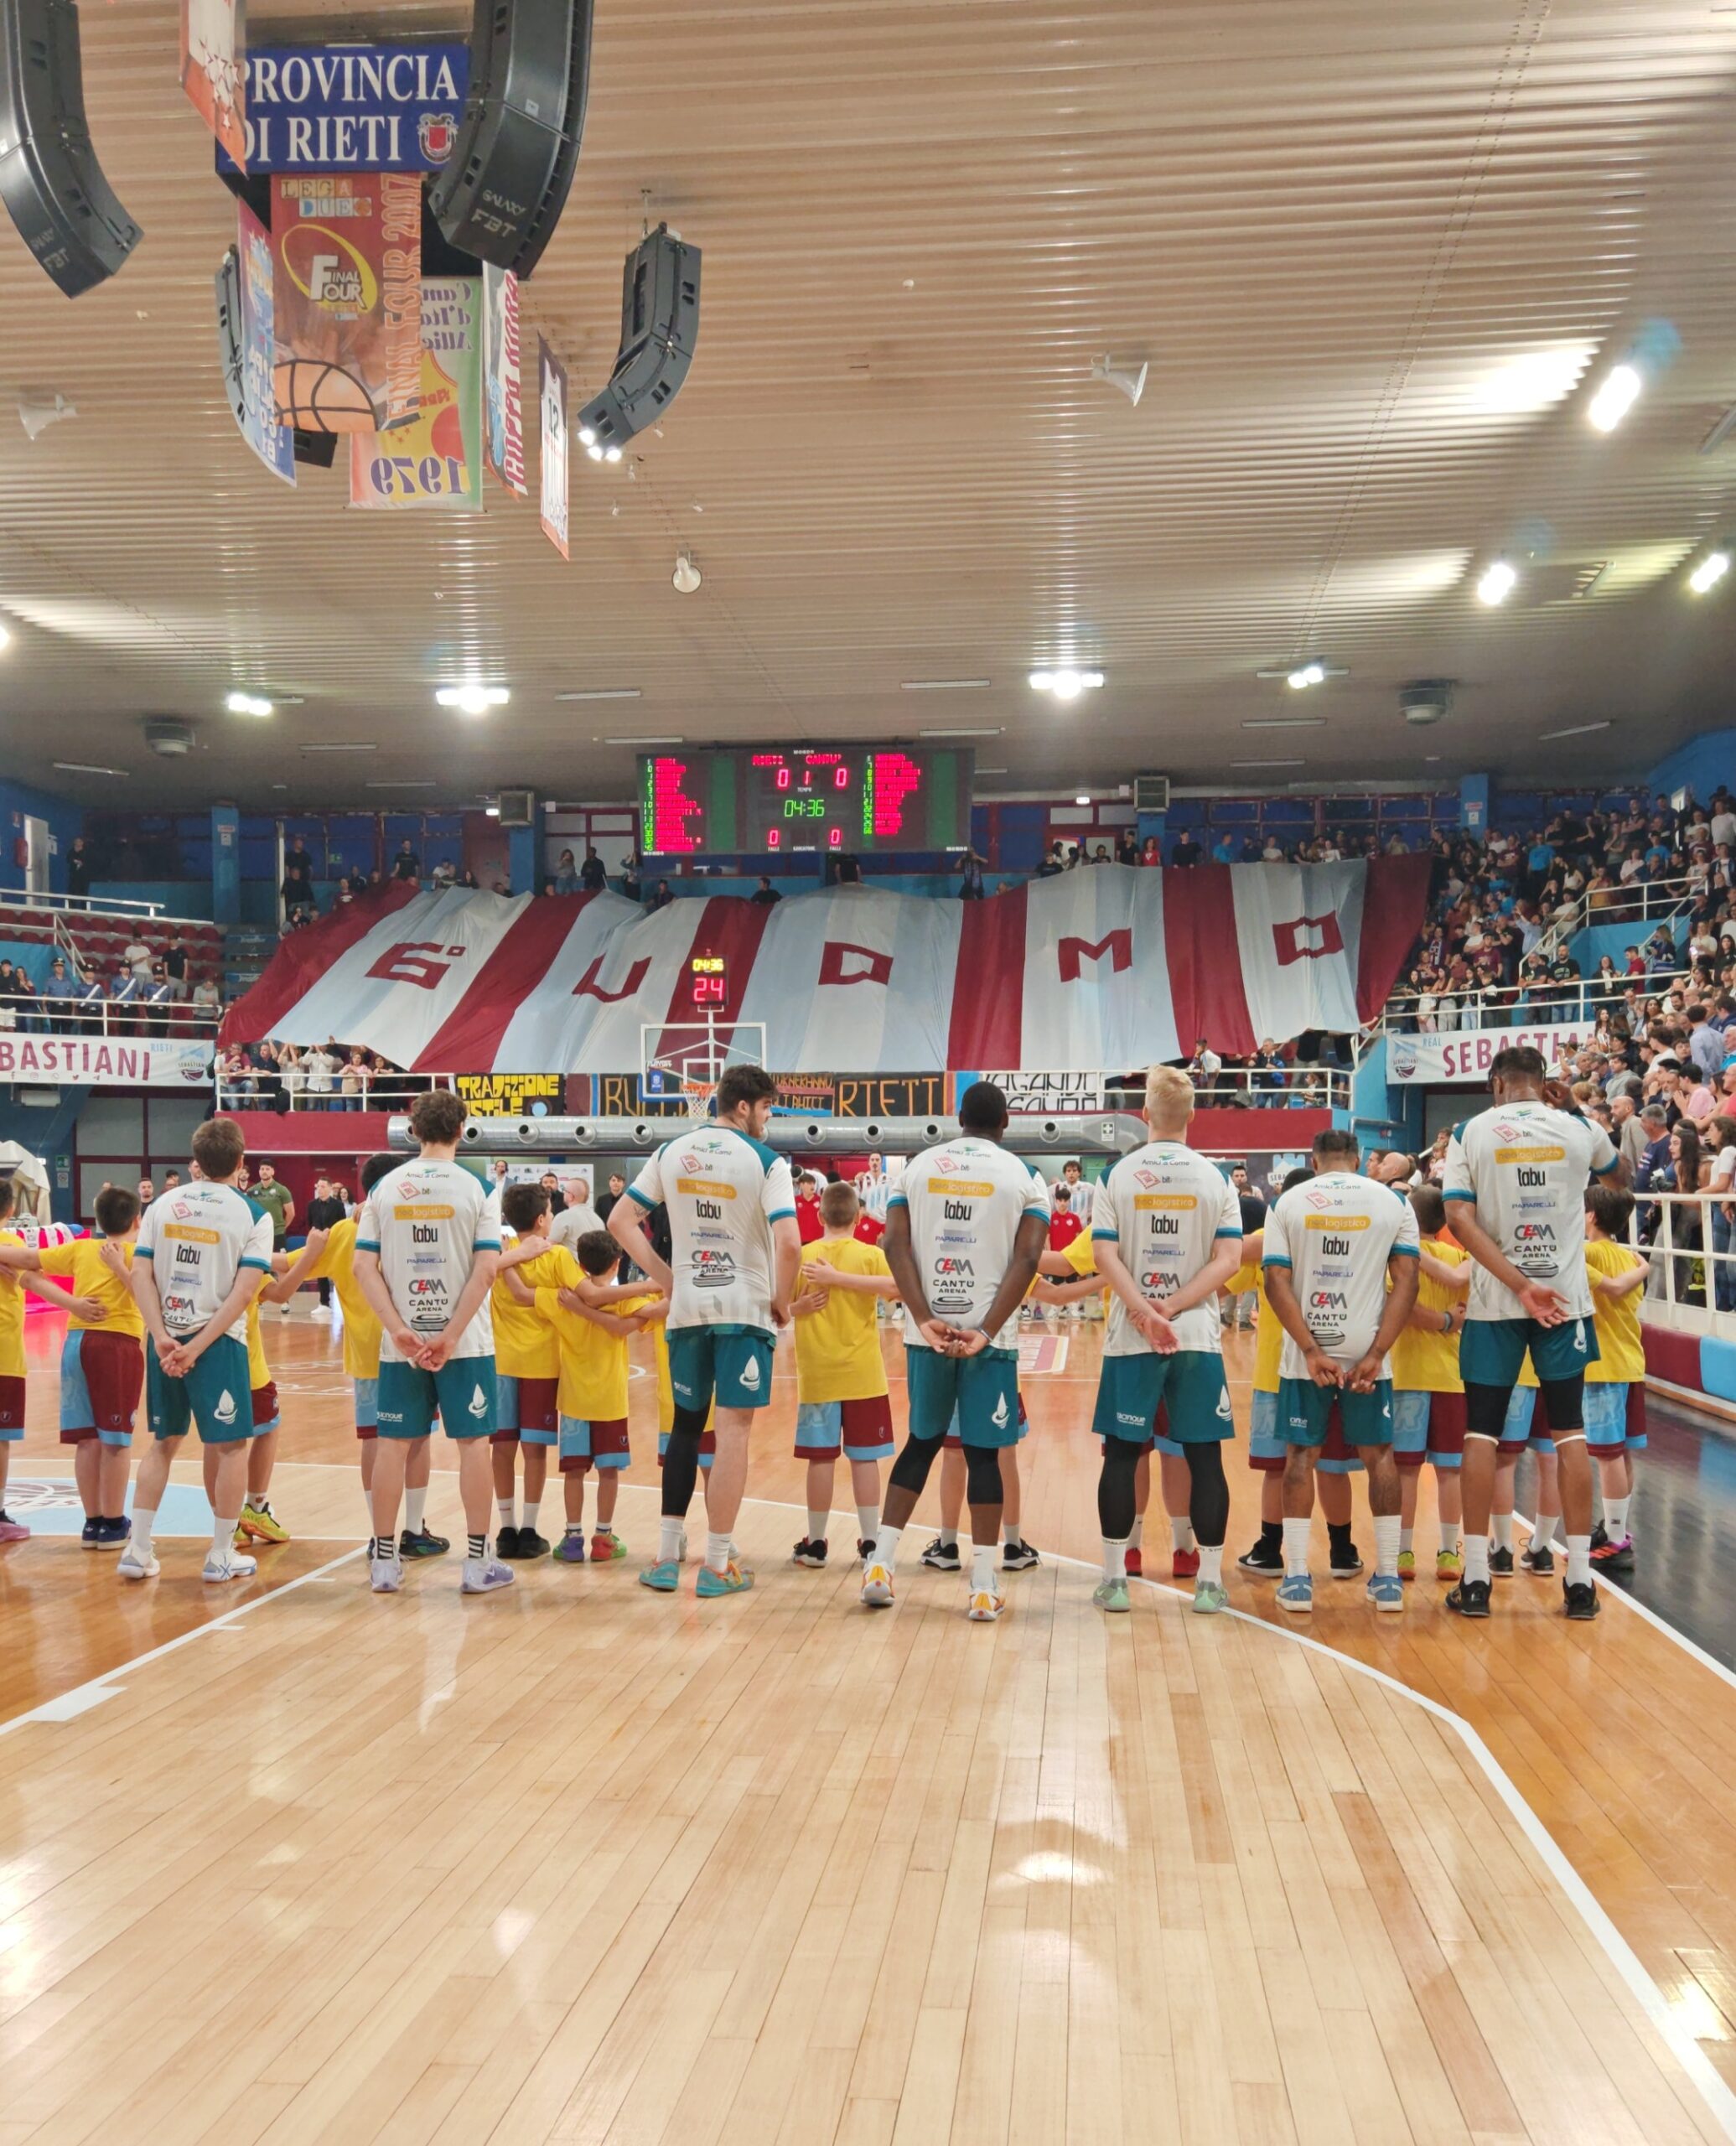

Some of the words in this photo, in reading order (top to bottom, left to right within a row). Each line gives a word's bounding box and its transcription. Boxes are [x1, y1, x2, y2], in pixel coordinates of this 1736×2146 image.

[286, 116, 402, 163] RIETI
[282, 179, 352, 198] LEGA
[302, 199, 352, 216] DUE
[381, 173, 423, 241] 2007
[471, 208, 516, 237] FBT
[382, 246, 422, 329] FOUR
[386, 334, 422, 420] FINAL
[778, 769, 789, 787] 0
[836, 768, 847, 786] 0
[784, 799, 825, 816] 04:36
[769, 829, 779, 845] 0
[830, 828, 841, 844] 0
[692, 958, 724, 972] 04:36
[693, 977, 723, 1002] 24
[1422, 1037, 1442, 1047] REAL
[839, 1078, 940, 1117] RIETI
[1517, 1167, 1546, 1187] tabu
[696, 1199, 722, 1220] tabu
[944, 1200, 972, 1221] tabu
[412, 1225, 438, 1243] tabu
[1151, 1214, 1179, 1235] tabu
[176, 1244, 200, 1265] tabu
[1322, 1235, 1350, 1256] tabu
